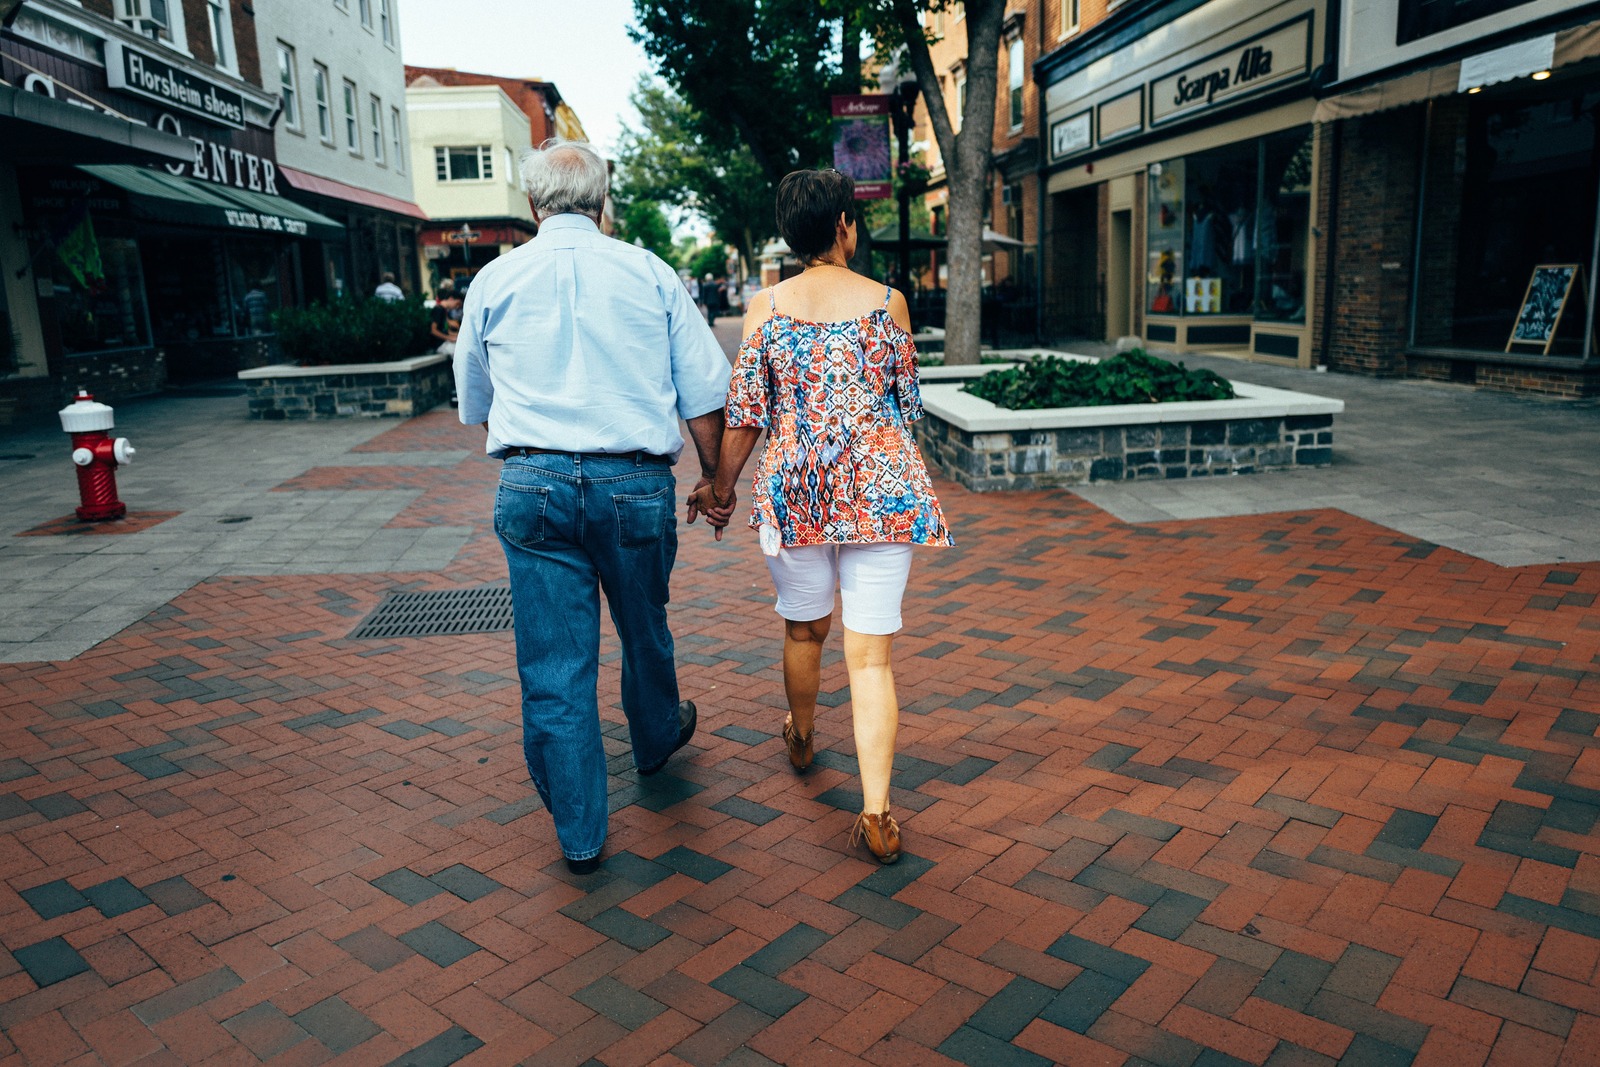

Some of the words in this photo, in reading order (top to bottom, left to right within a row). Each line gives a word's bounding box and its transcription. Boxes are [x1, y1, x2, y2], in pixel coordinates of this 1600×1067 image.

[128, 54, 202, 108] Florsheim
[204, 87, 242, 123] shoes
[1175, 68, 1230, 105] Scarpa
[71, 198, 119, 210] CNTER
